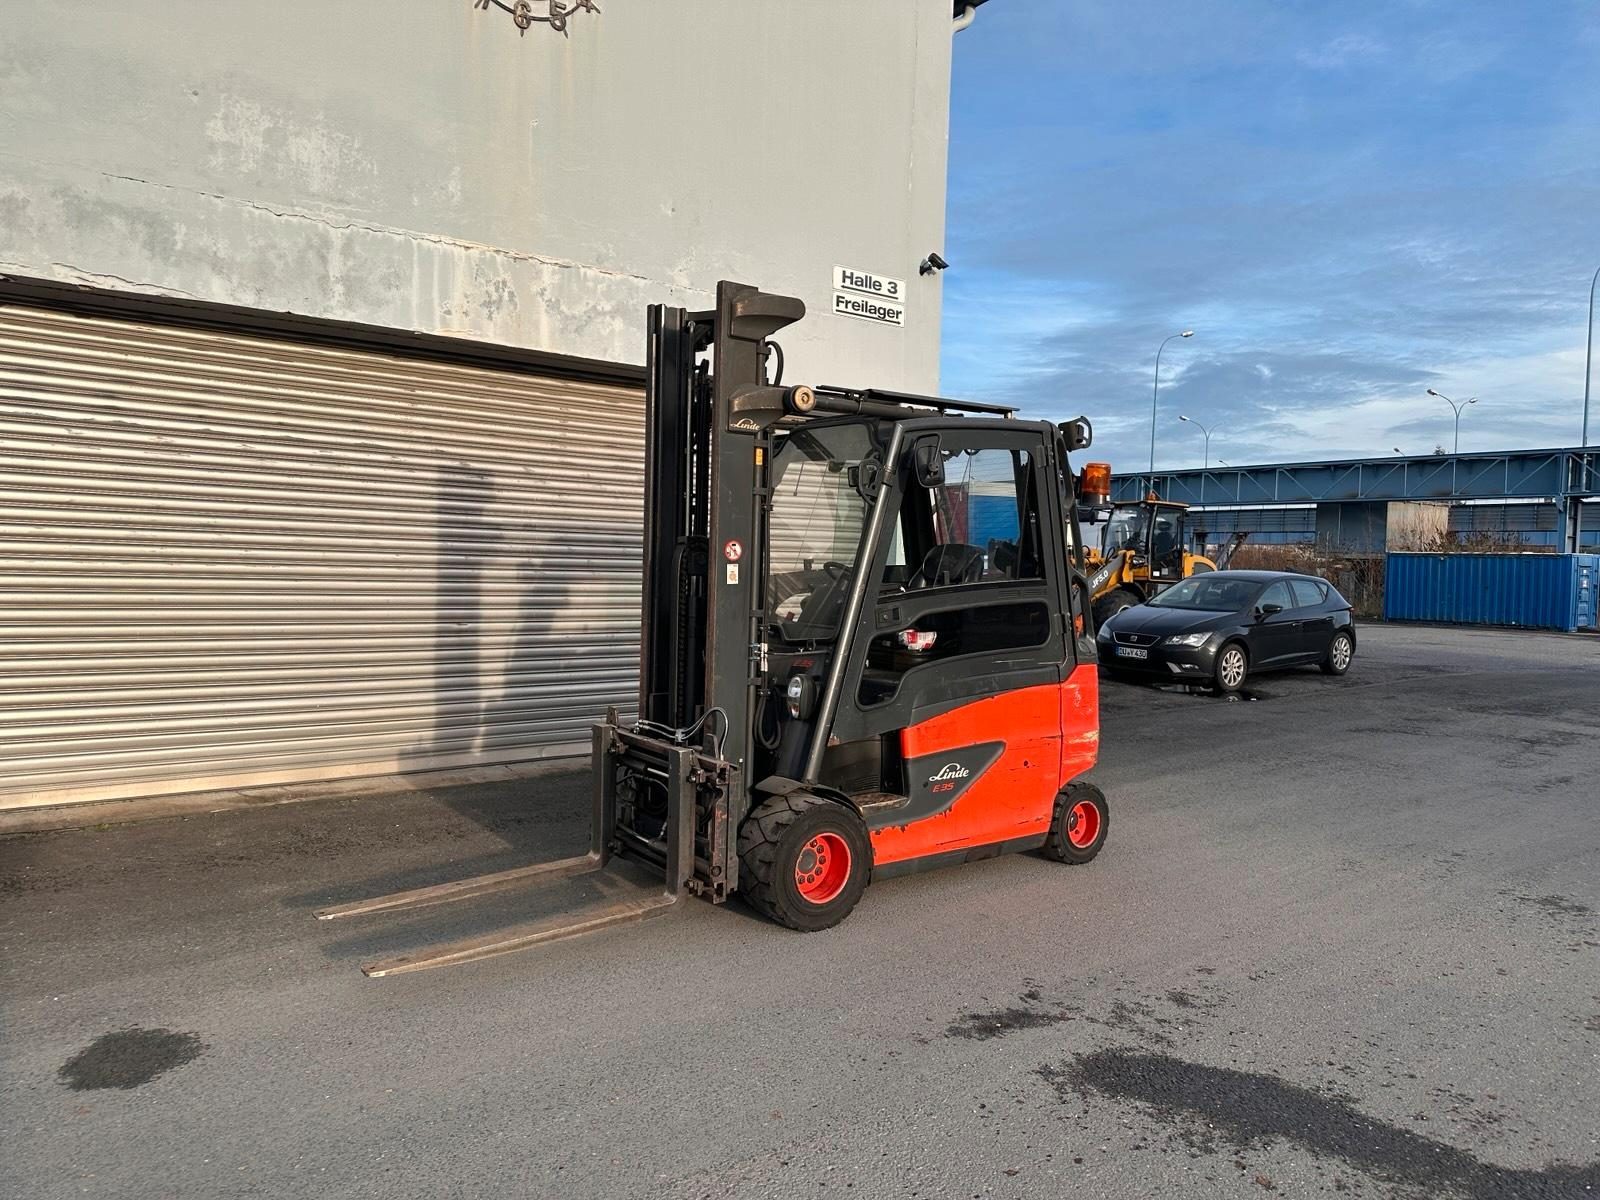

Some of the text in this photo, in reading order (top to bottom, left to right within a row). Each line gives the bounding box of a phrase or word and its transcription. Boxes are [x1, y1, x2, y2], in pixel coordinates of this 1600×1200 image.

[514, 0, 532, 29] 6
[841, 270, 898, 295] Halle 3
[835, 295, 902, 320] Freilager
[730, 418, 760, 431] Linde
[929, 763, 969, 781] Linde
